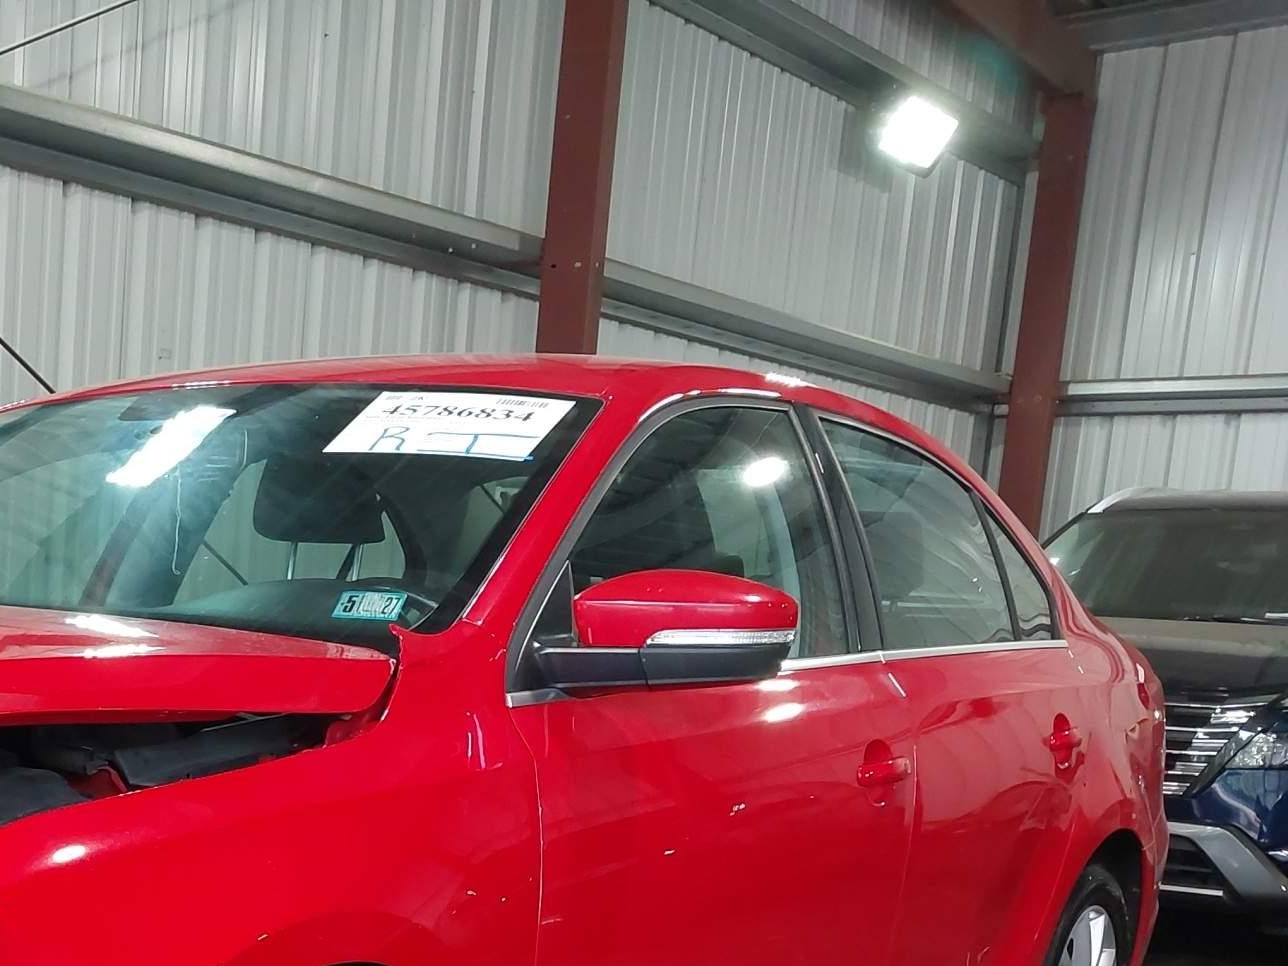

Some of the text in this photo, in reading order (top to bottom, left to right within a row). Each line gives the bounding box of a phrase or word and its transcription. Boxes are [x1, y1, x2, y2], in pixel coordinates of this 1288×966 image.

[383, 403, 535, 422] 45786834
[368, 425, 411, 452] R
[341, 594, 360, 613] 5
[381, 596, 401, 617] 27
